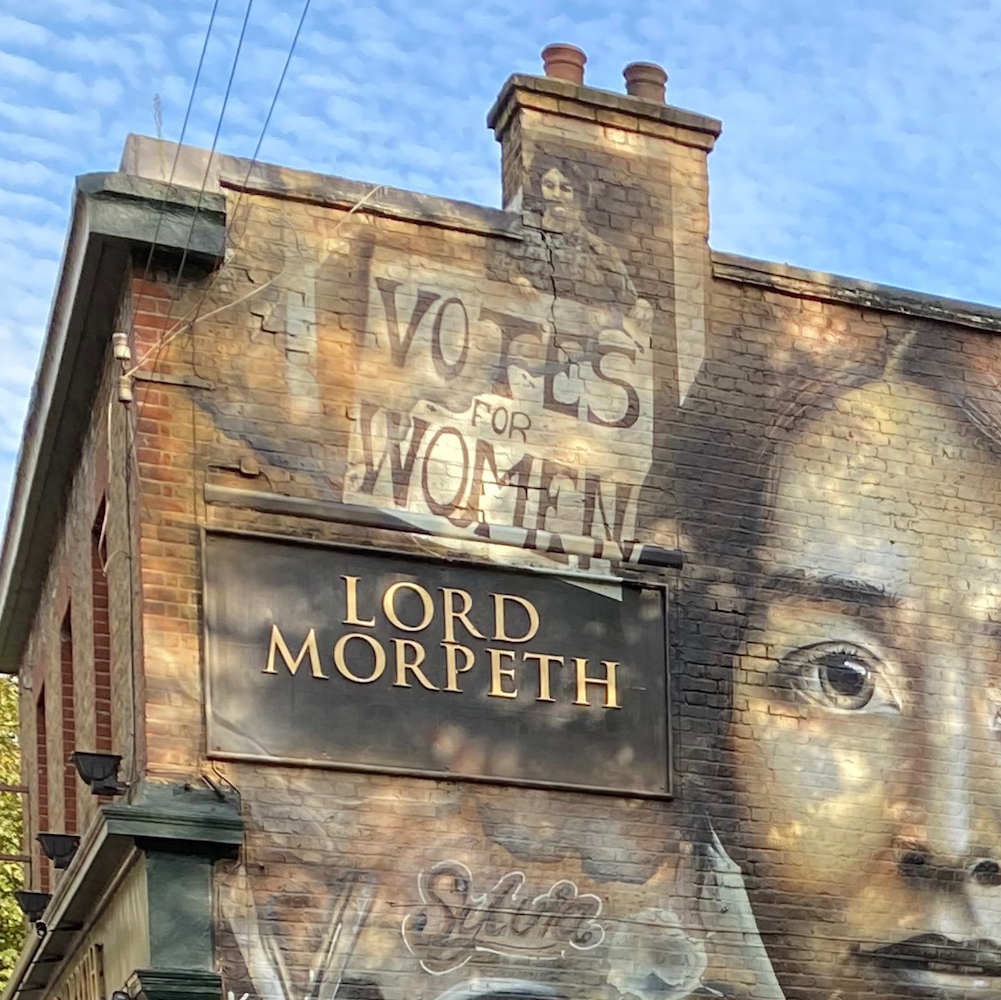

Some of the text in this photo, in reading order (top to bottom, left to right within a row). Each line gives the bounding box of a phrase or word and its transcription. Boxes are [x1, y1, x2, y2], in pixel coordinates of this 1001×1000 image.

[375, 277, 640, 428] VOTES
[471, 400, 532, 443] FOR
[360, 402, 640, 570] WOMEN
[341, 575, 540, 643] LORD
[262, 624, 622, 709] MORPETH
